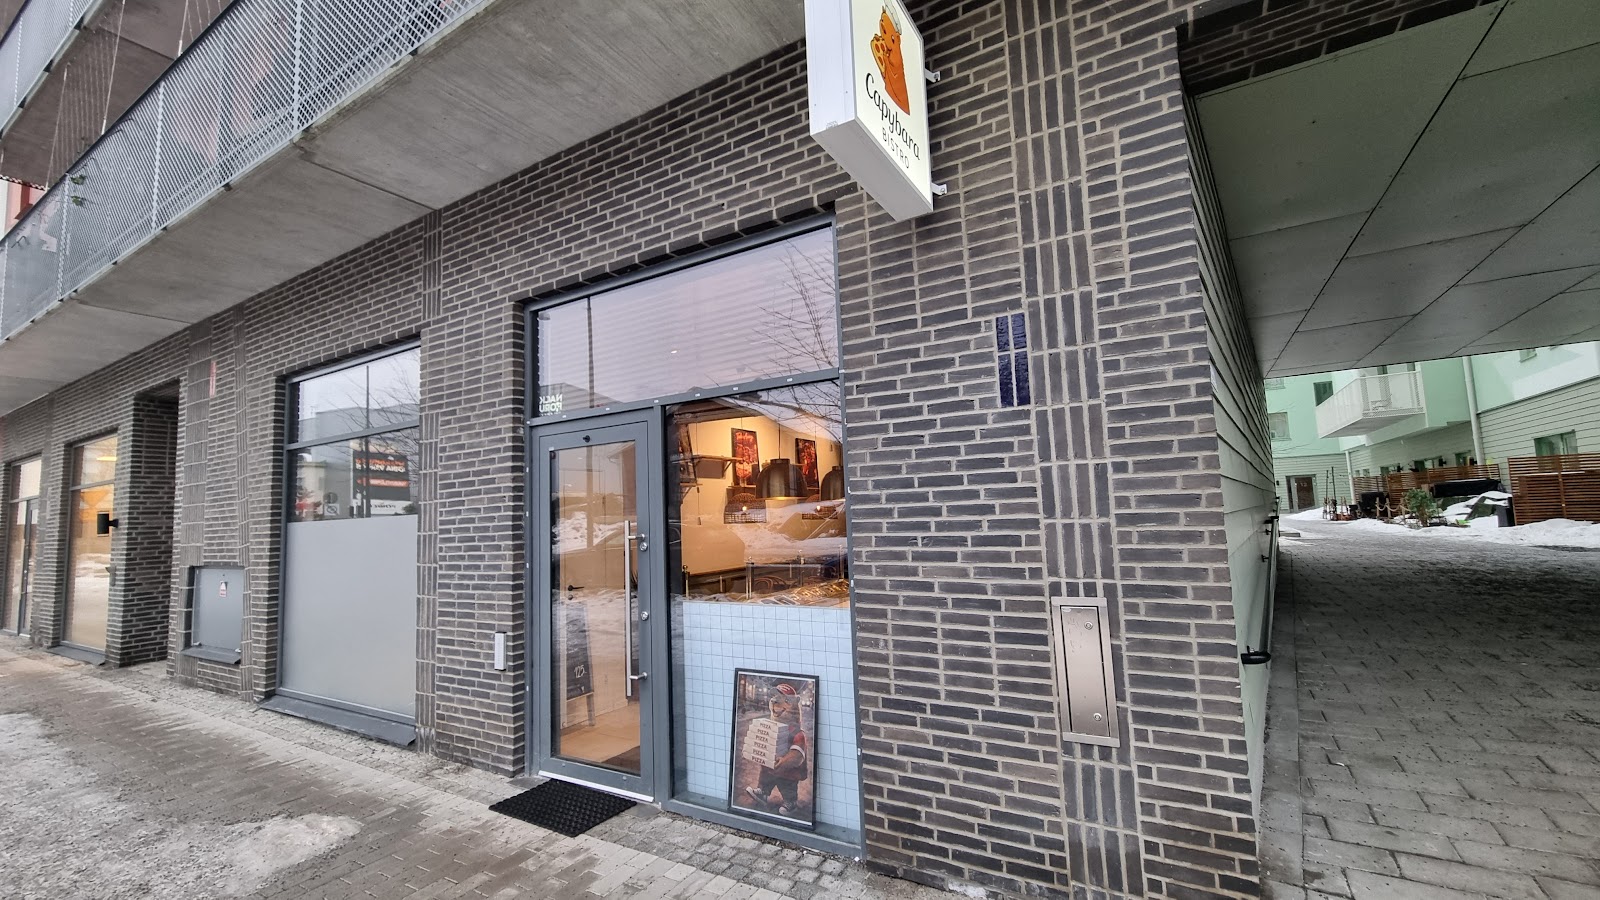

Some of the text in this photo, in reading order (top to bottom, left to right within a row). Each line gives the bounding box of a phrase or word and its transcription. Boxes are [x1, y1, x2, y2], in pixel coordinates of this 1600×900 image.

[865, 72, 920, 160] Capybara
[882, 126, 910, 169] BISTRO
[760, 722, 771, 730] PIZZA
[757, 728, 770, 737] PIZZA
[755, 734, 768, 743] PIZZA
[753, 741, 767, 750] PIZZA
[752, 748, 766, 758] PIZZA
[751, 755, 766, 765] PIZZA
